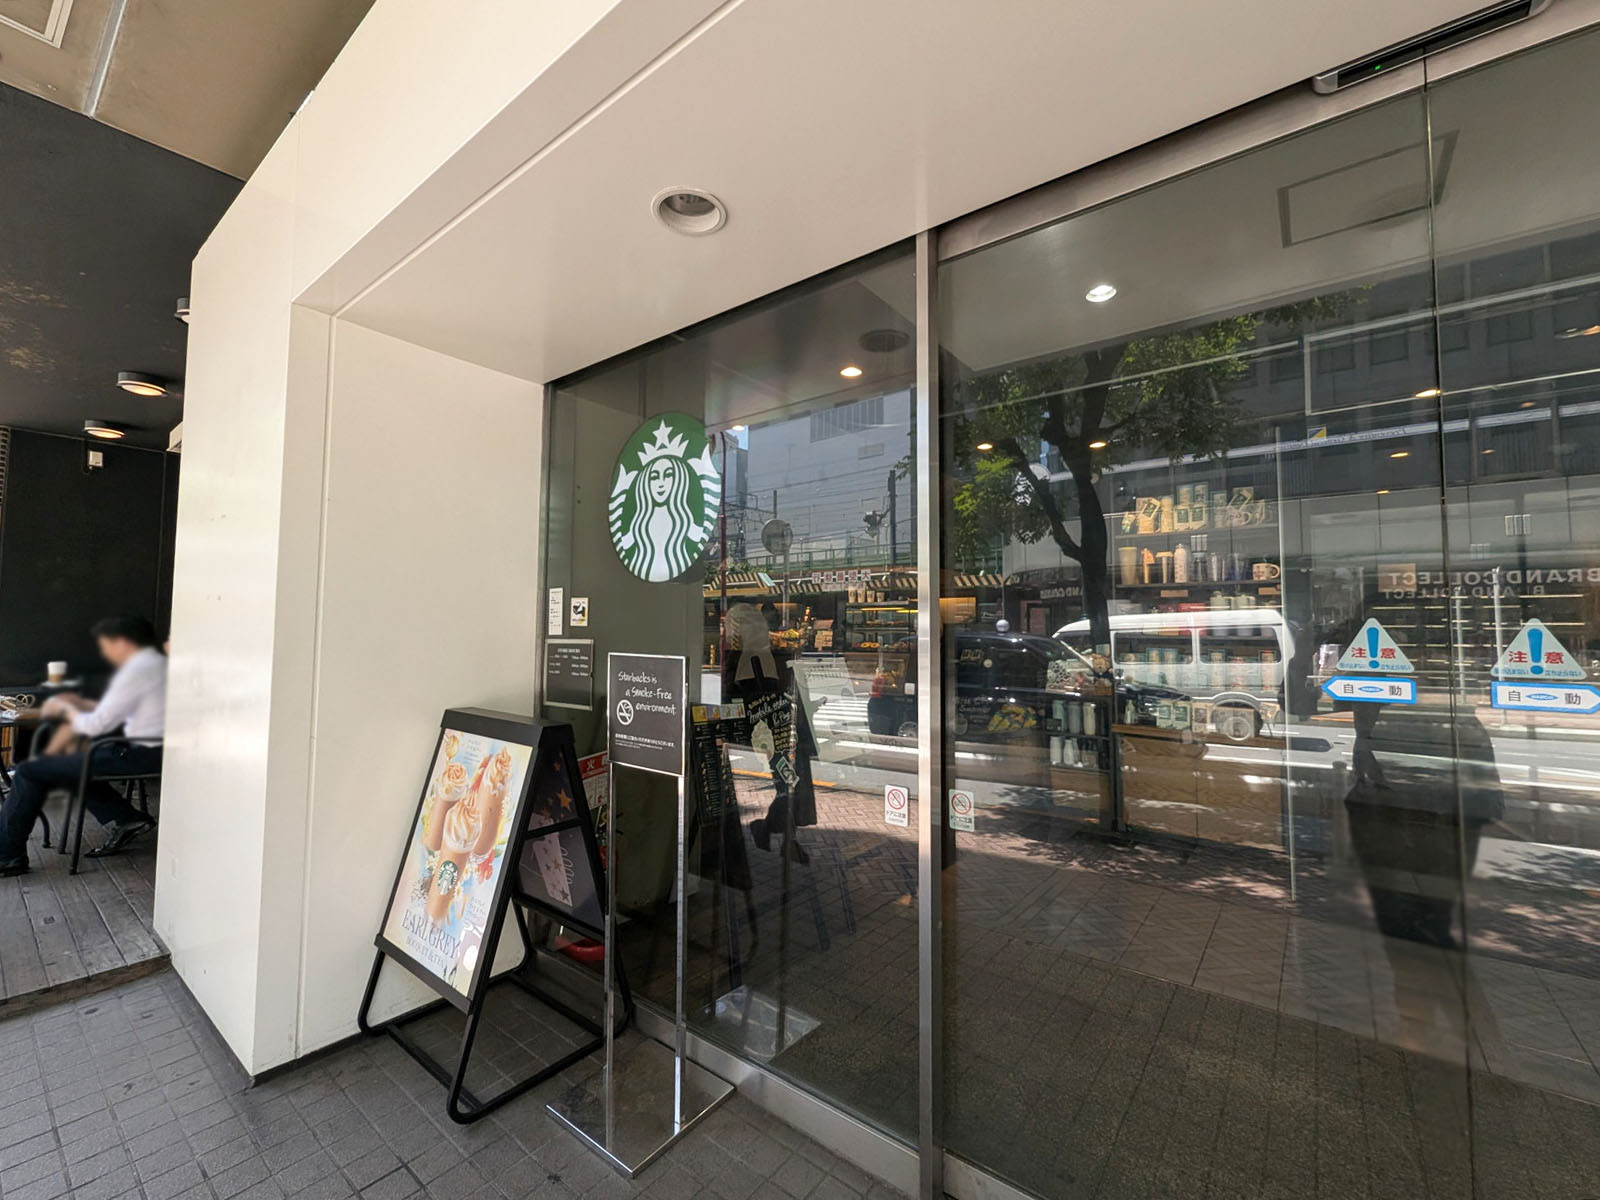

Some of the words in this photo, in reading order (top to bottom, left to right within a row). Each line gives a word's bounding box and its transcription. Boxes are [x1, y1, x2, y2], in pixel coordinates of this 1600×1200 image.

[618, 671, 651, 684] Starbucks
[651, 675, 658, 684] is
[625, 689, 631, 697] a
[632, 686, 672, 700] Smoke-Free
[401, 909, 428, 942] EARL
[428, 925, 461, 959] GREY
